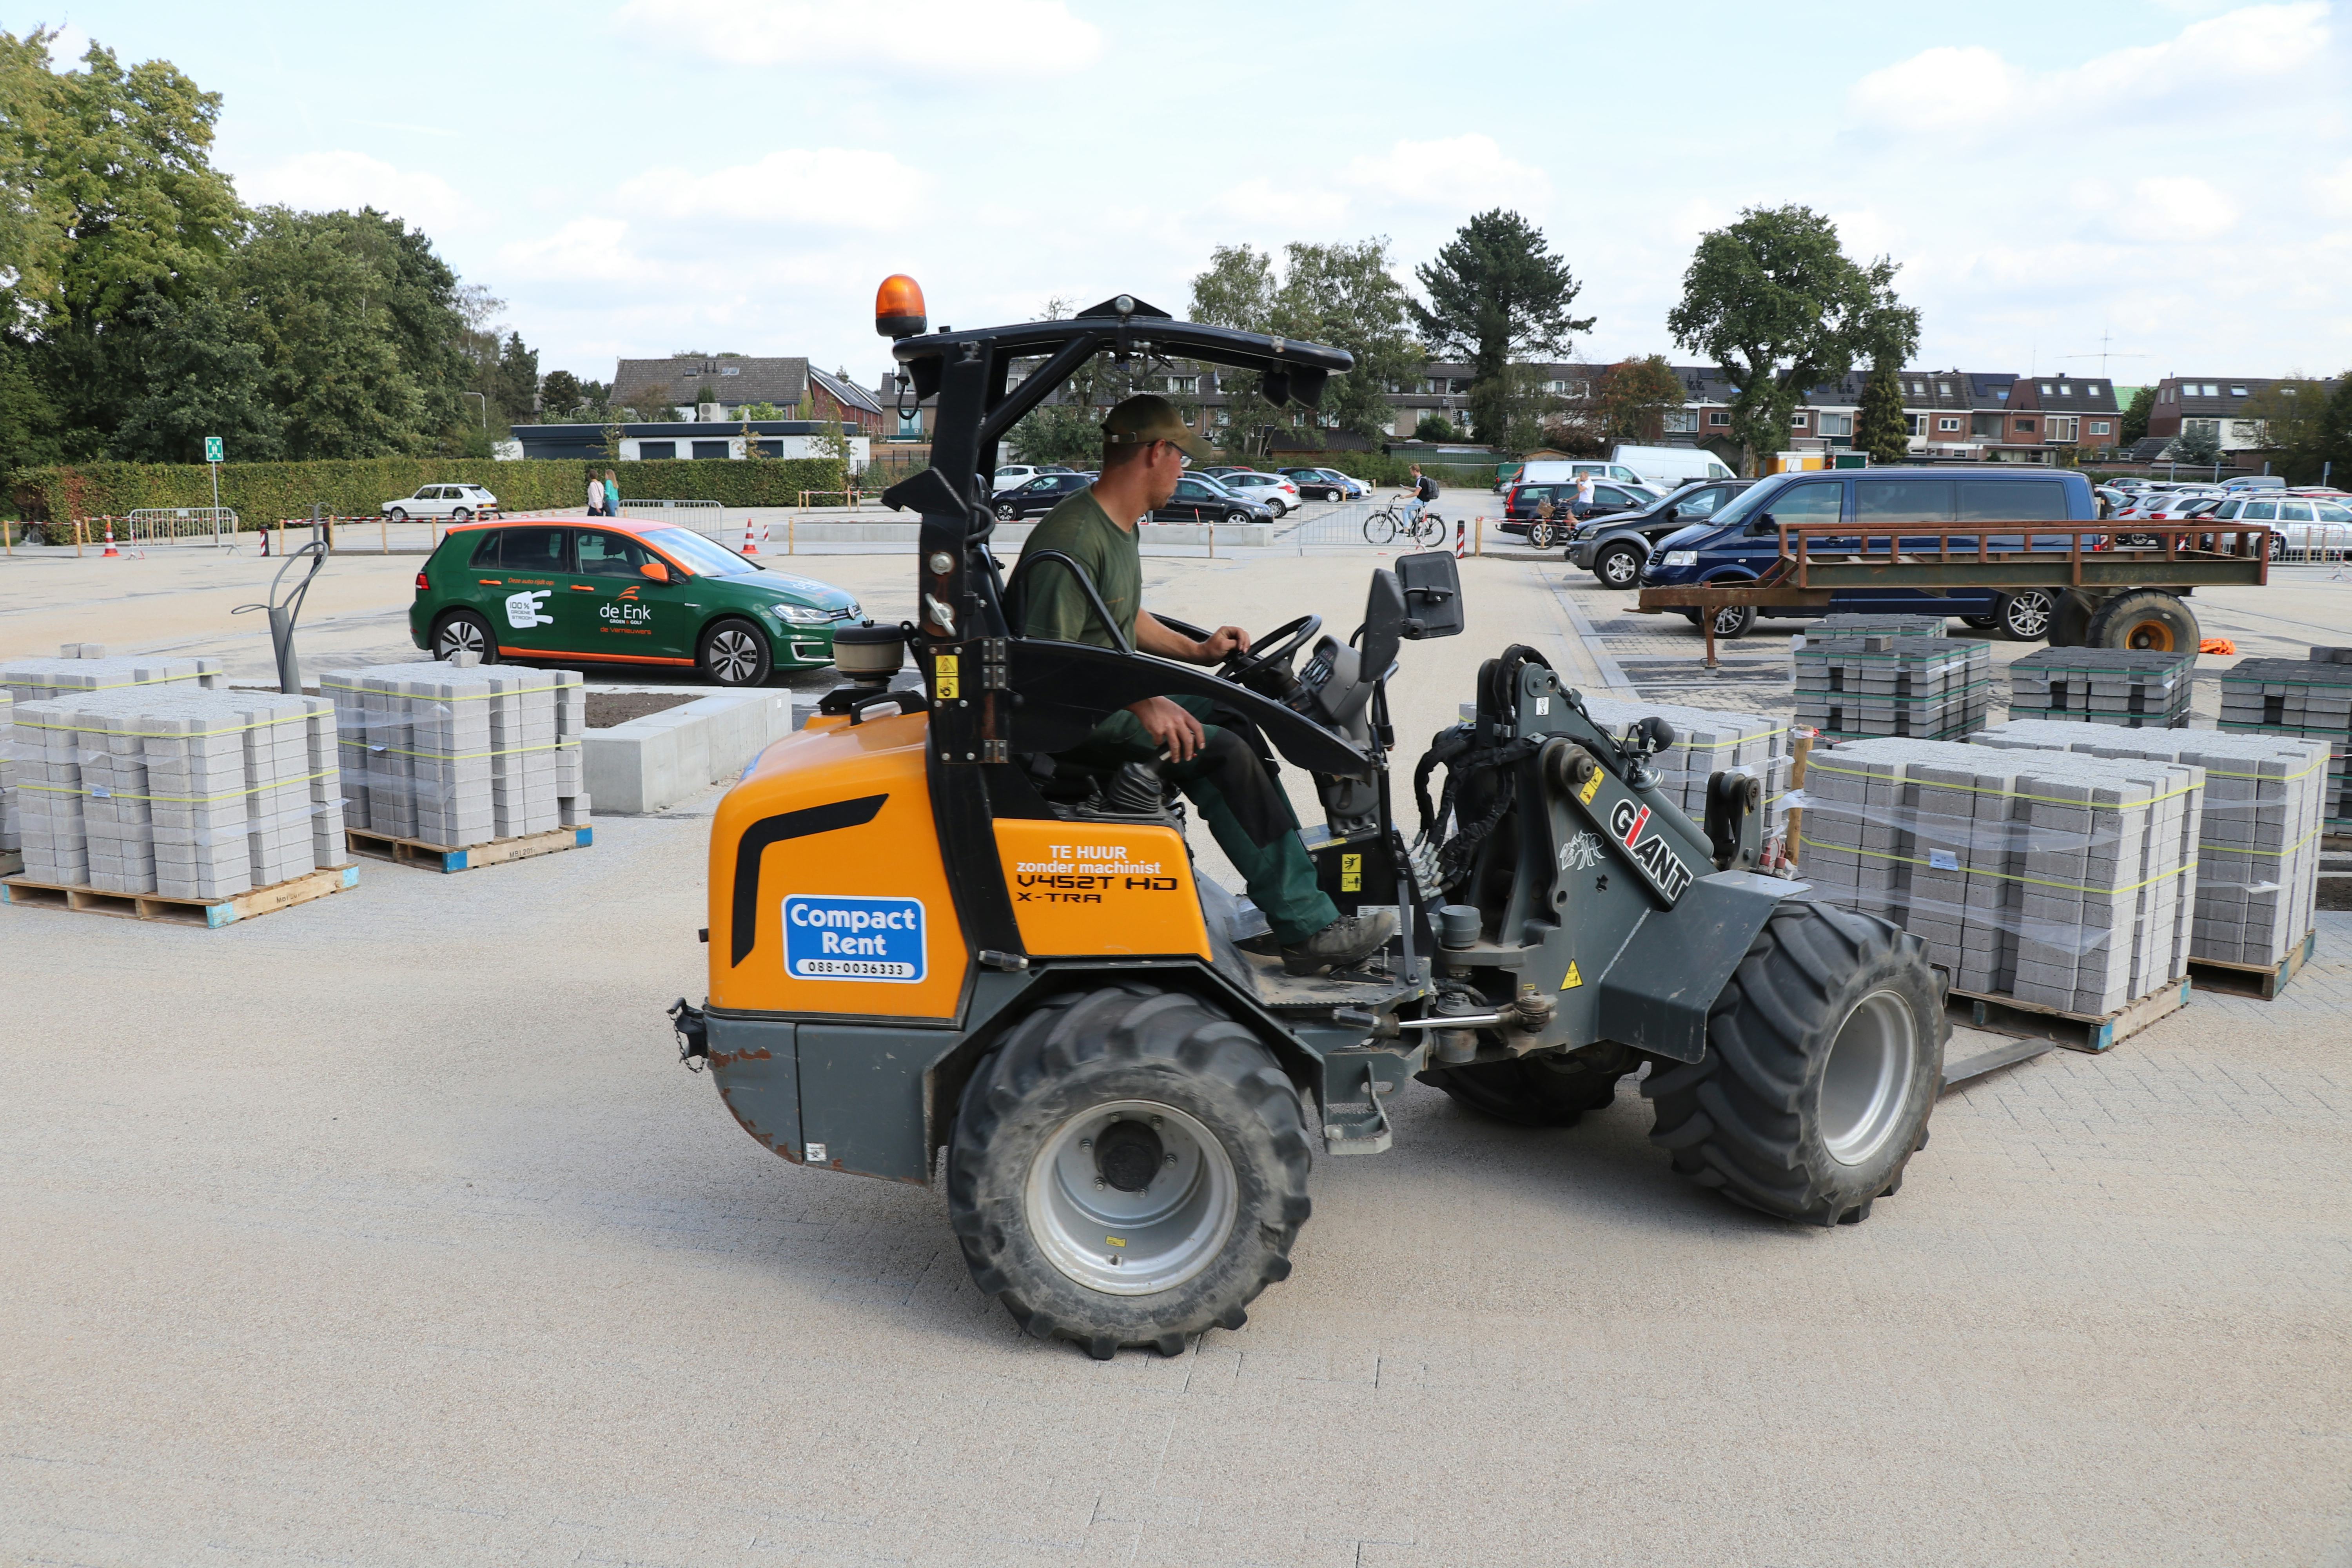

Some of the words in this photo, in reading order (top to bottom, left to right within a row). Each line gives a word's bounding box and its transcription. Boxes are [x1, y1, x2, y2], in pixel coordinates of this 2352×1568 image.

[600, 603, 619, 618] de
[624, 604, 652, 620] Enk
[510, 849, 521, 858] MBI
[1049, 845, 1072, 858] TE
[1076, 846, 1128, 859] HUUR
[1016, 860, 1075, 873] zonder
[1079, 860, 1161, 874] machinist
[1017, 875, 1114, 889] V452T
[1125, 877, 1178, 890] HD
[1016, 892, 1102, 903] X-TRA
[790, 903, 917, 933] Compact
[822, 931, 887, 956] Rent
[808, 962, 904, 975] 088-0036333
